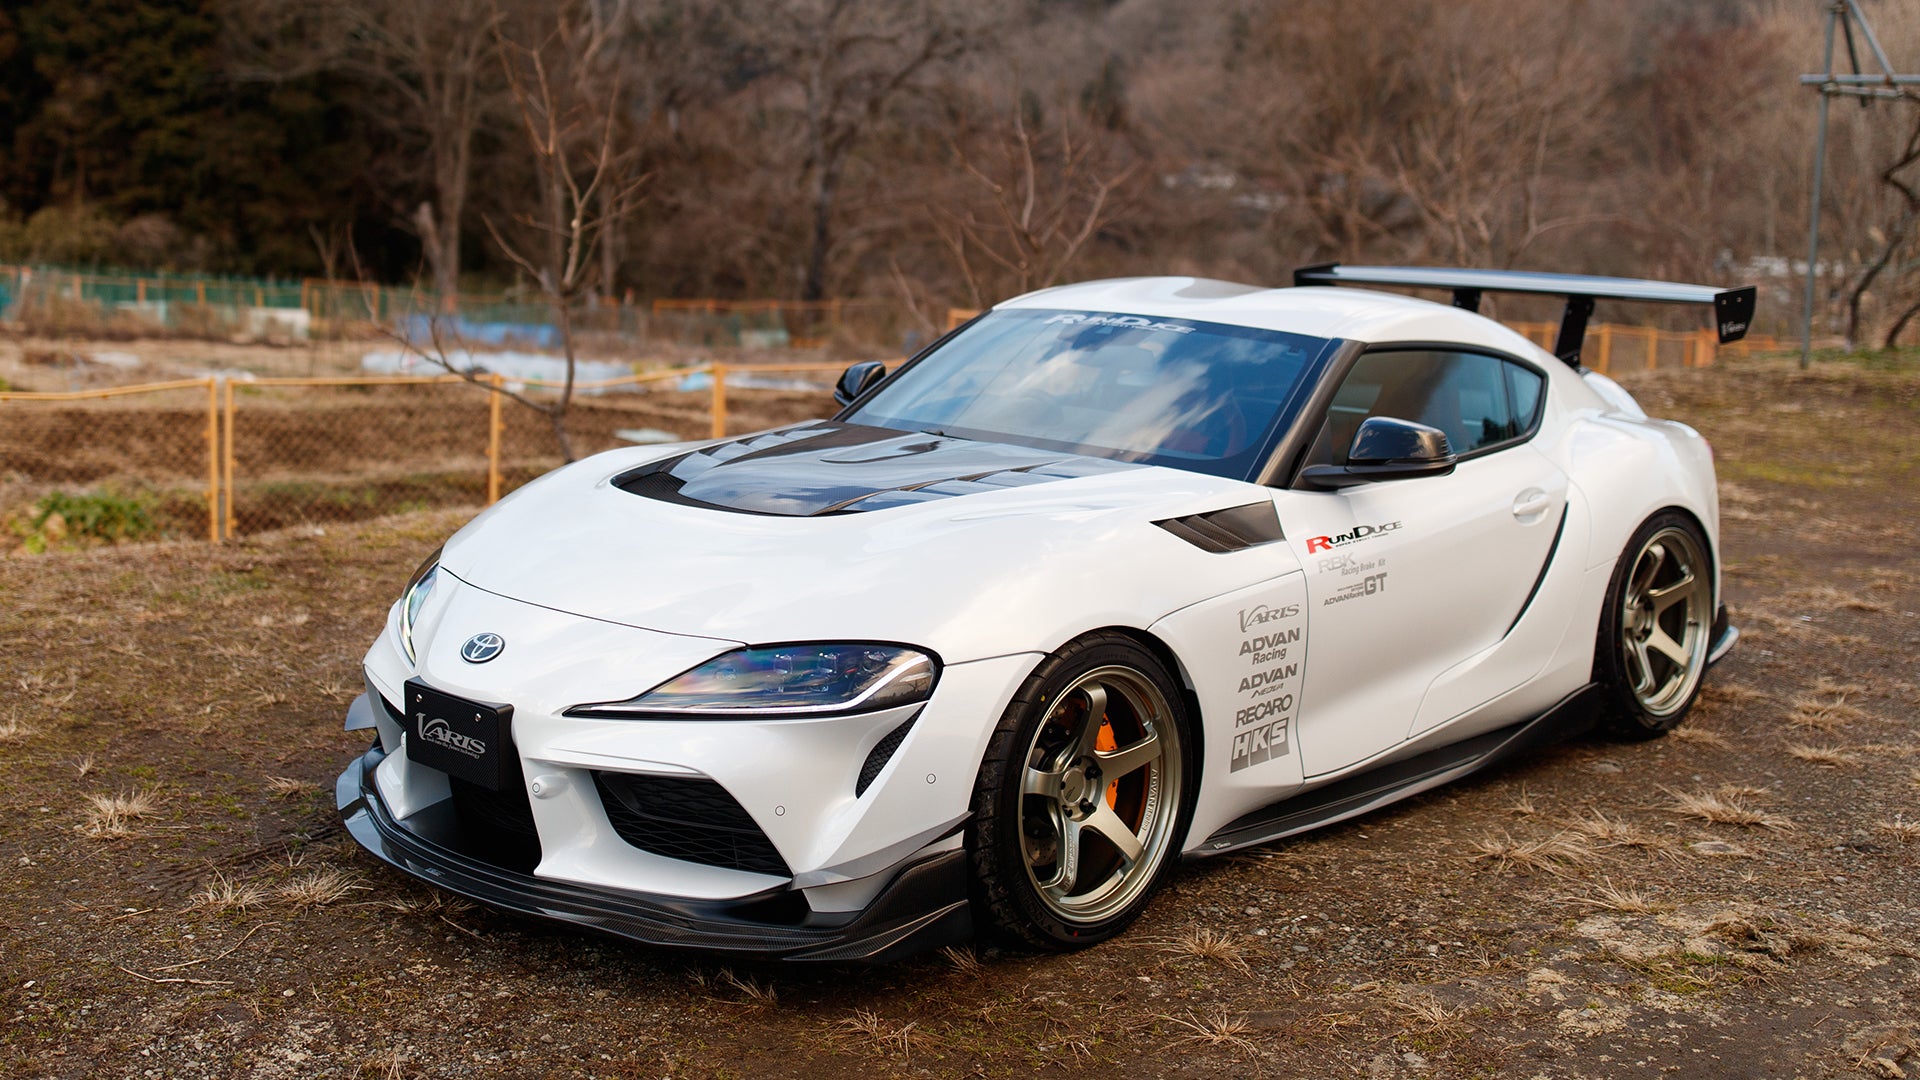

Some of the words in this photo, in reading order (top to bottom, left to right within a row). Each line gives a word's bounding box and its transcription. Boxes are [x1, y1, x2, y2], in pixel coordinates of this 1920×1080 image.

[1318, 552, 1357, 574] RBK
[1237, 603, 1300, 633] VARIS
[1239, 627, 1300, 656] ADVAN
[1252, 648, 1287, 665] Racing
[1238, 663, 1298, 693] ADVAN
[1235, 693, 1293, 728] RECARO
[415, 712, 486, 754] VARIS
[1231, 718, 1289, 765] HKS
